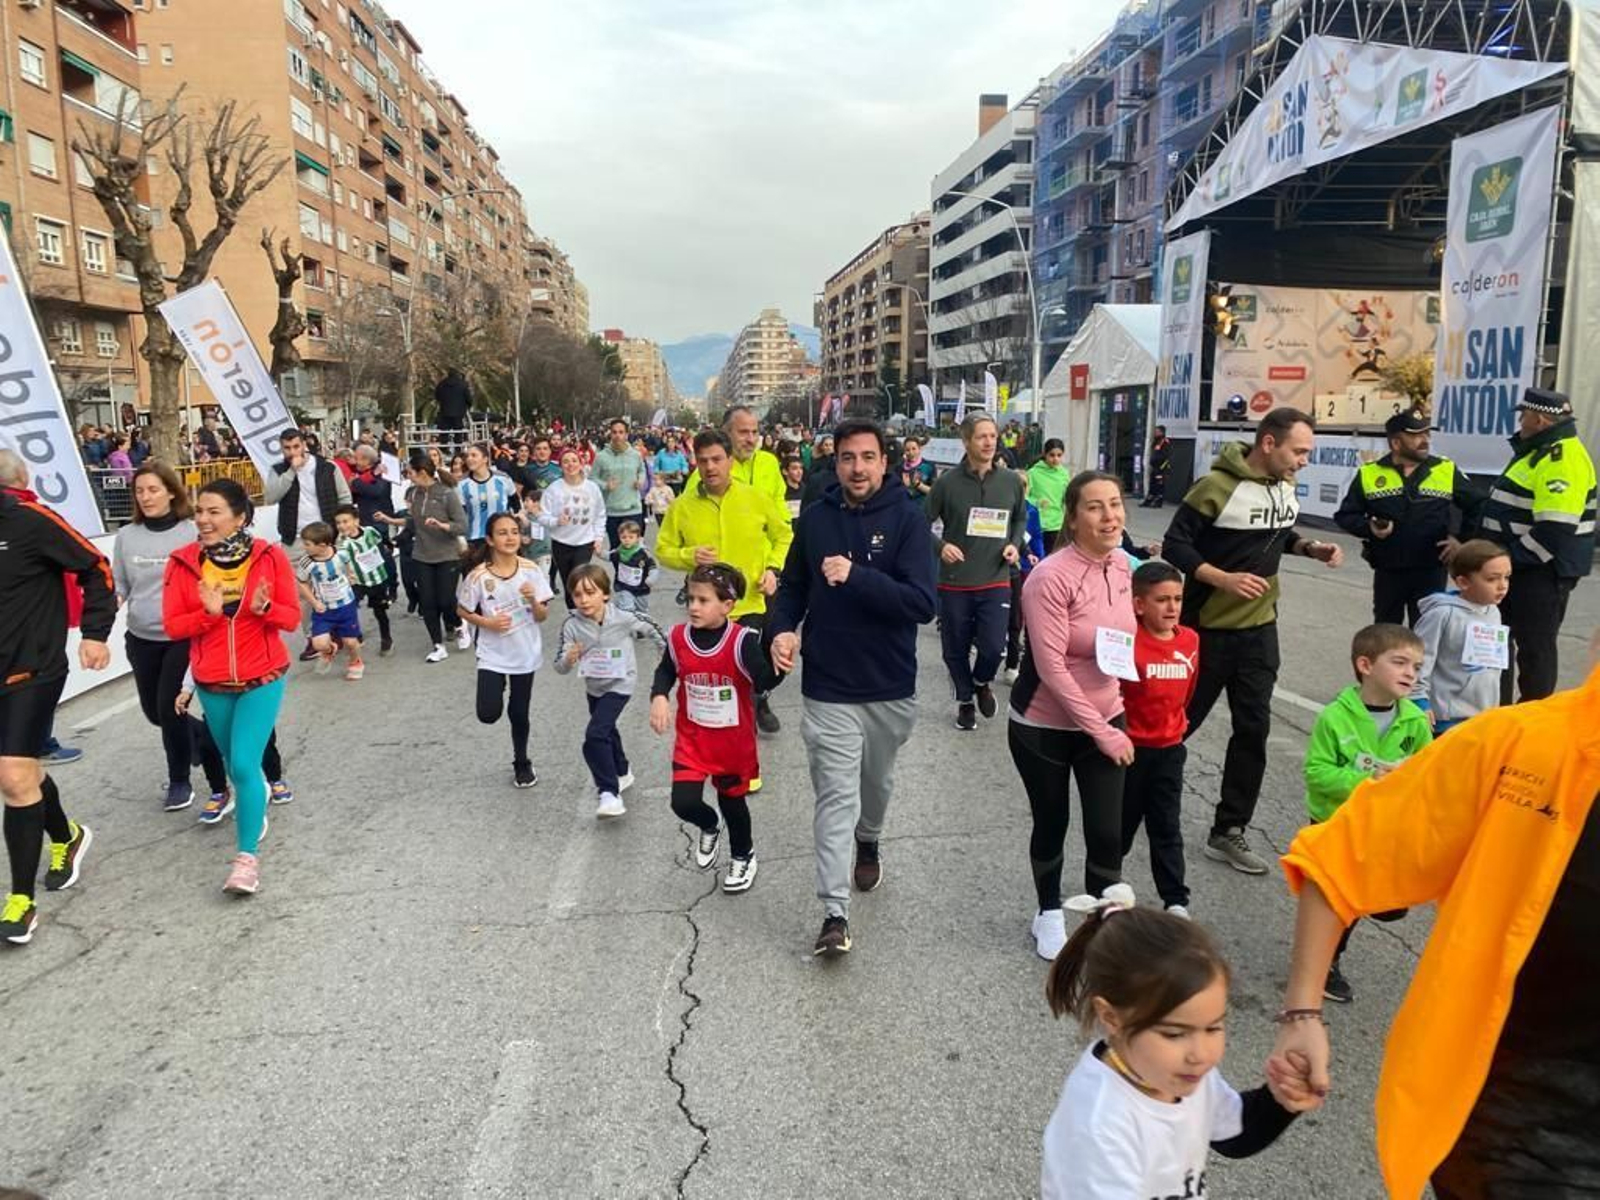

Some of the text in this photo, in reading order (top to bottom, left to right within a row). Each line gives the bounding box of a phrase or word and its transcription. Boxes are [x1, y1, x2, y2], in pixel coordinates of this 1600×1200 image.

[1465, 326, 1524, 379] SAN
[1172, 353, 1192, 384] SAN
[1327, 401, 1335, 417] 2
[1359, 395, 1366, 414] 1
[1437, 379, 1518, 435] ANTÓN
[1146, 663, 1188, 679] PUMA
